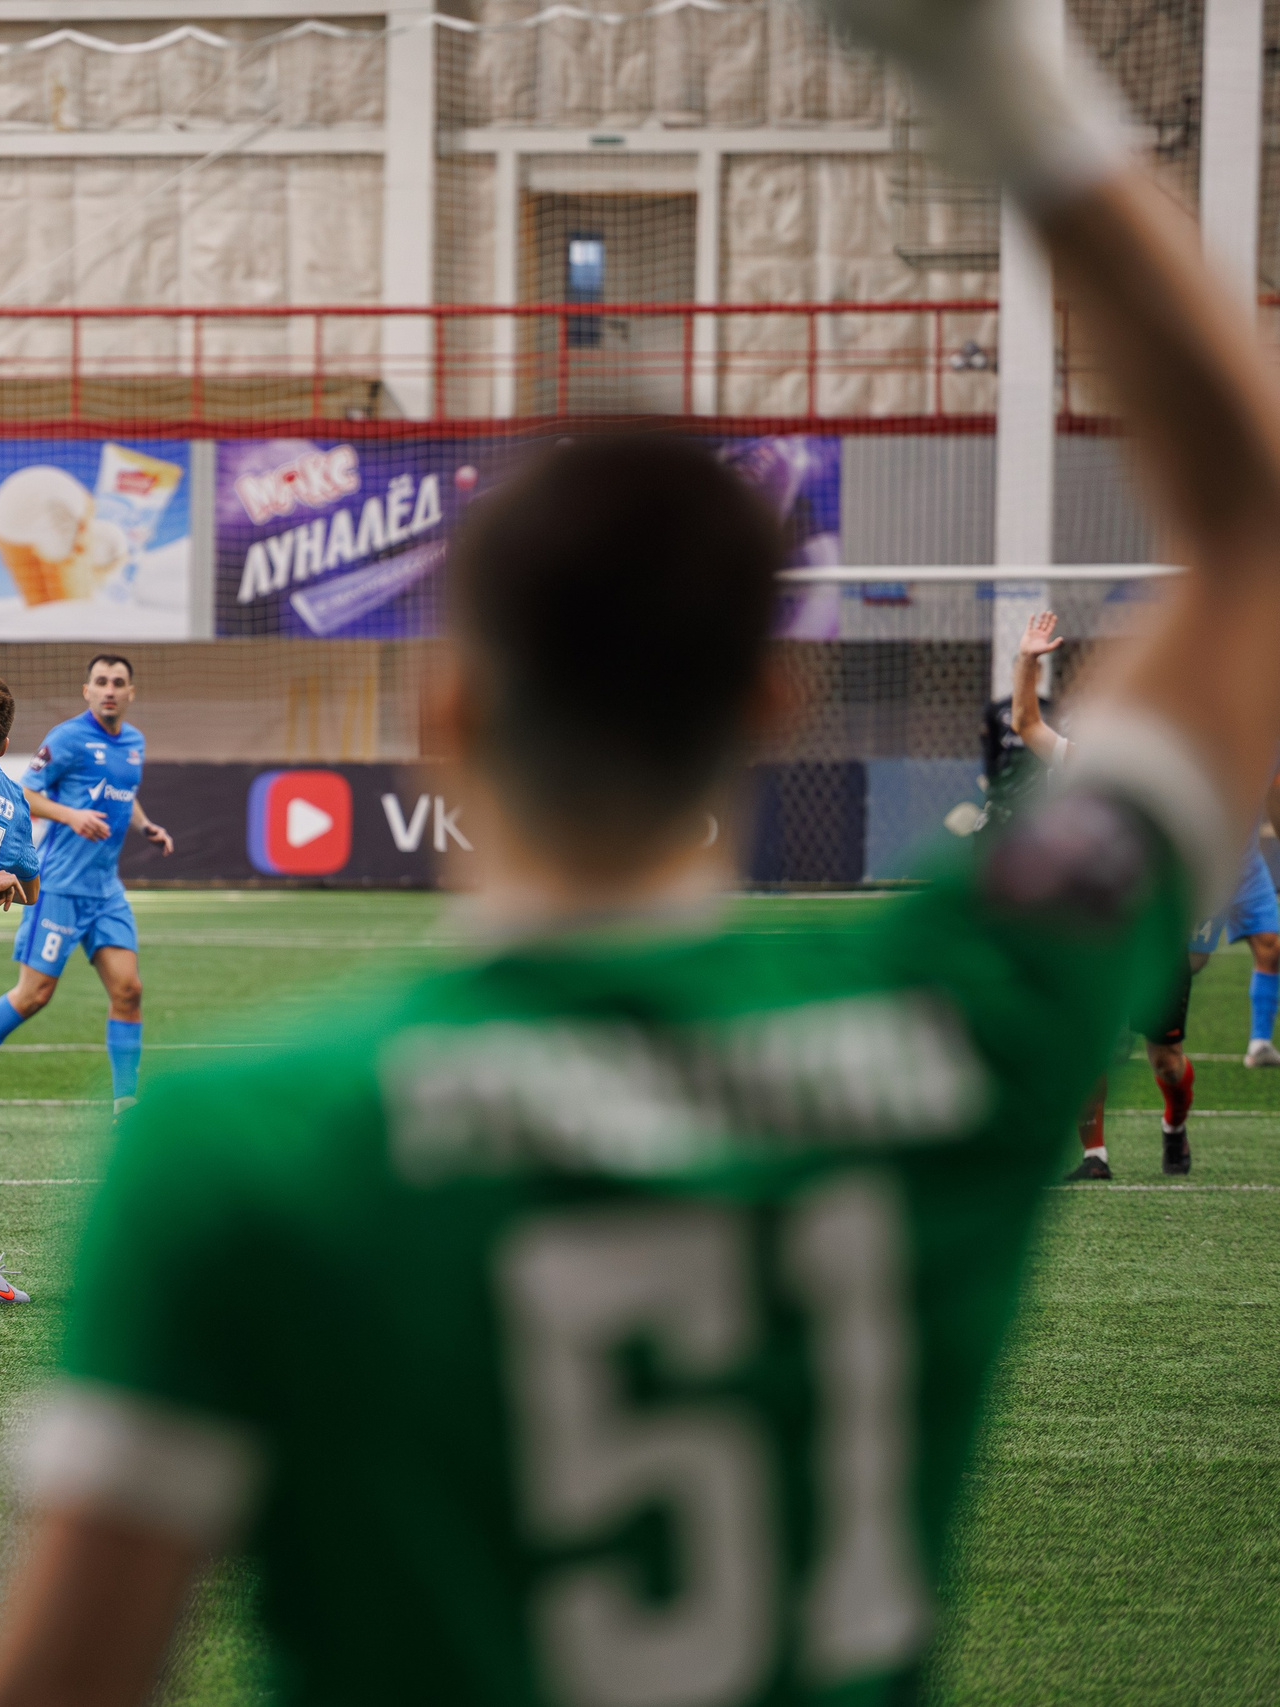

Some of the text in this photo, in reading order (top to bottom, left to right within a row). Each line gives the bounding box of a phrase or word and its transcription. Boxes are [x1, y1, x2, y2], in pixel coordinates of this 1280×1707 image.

[237, 472, 443, 603] ЛУНАЛЁД
[41, 932, 62, 963] 8
[495, 1172, 930, 1706] 51
